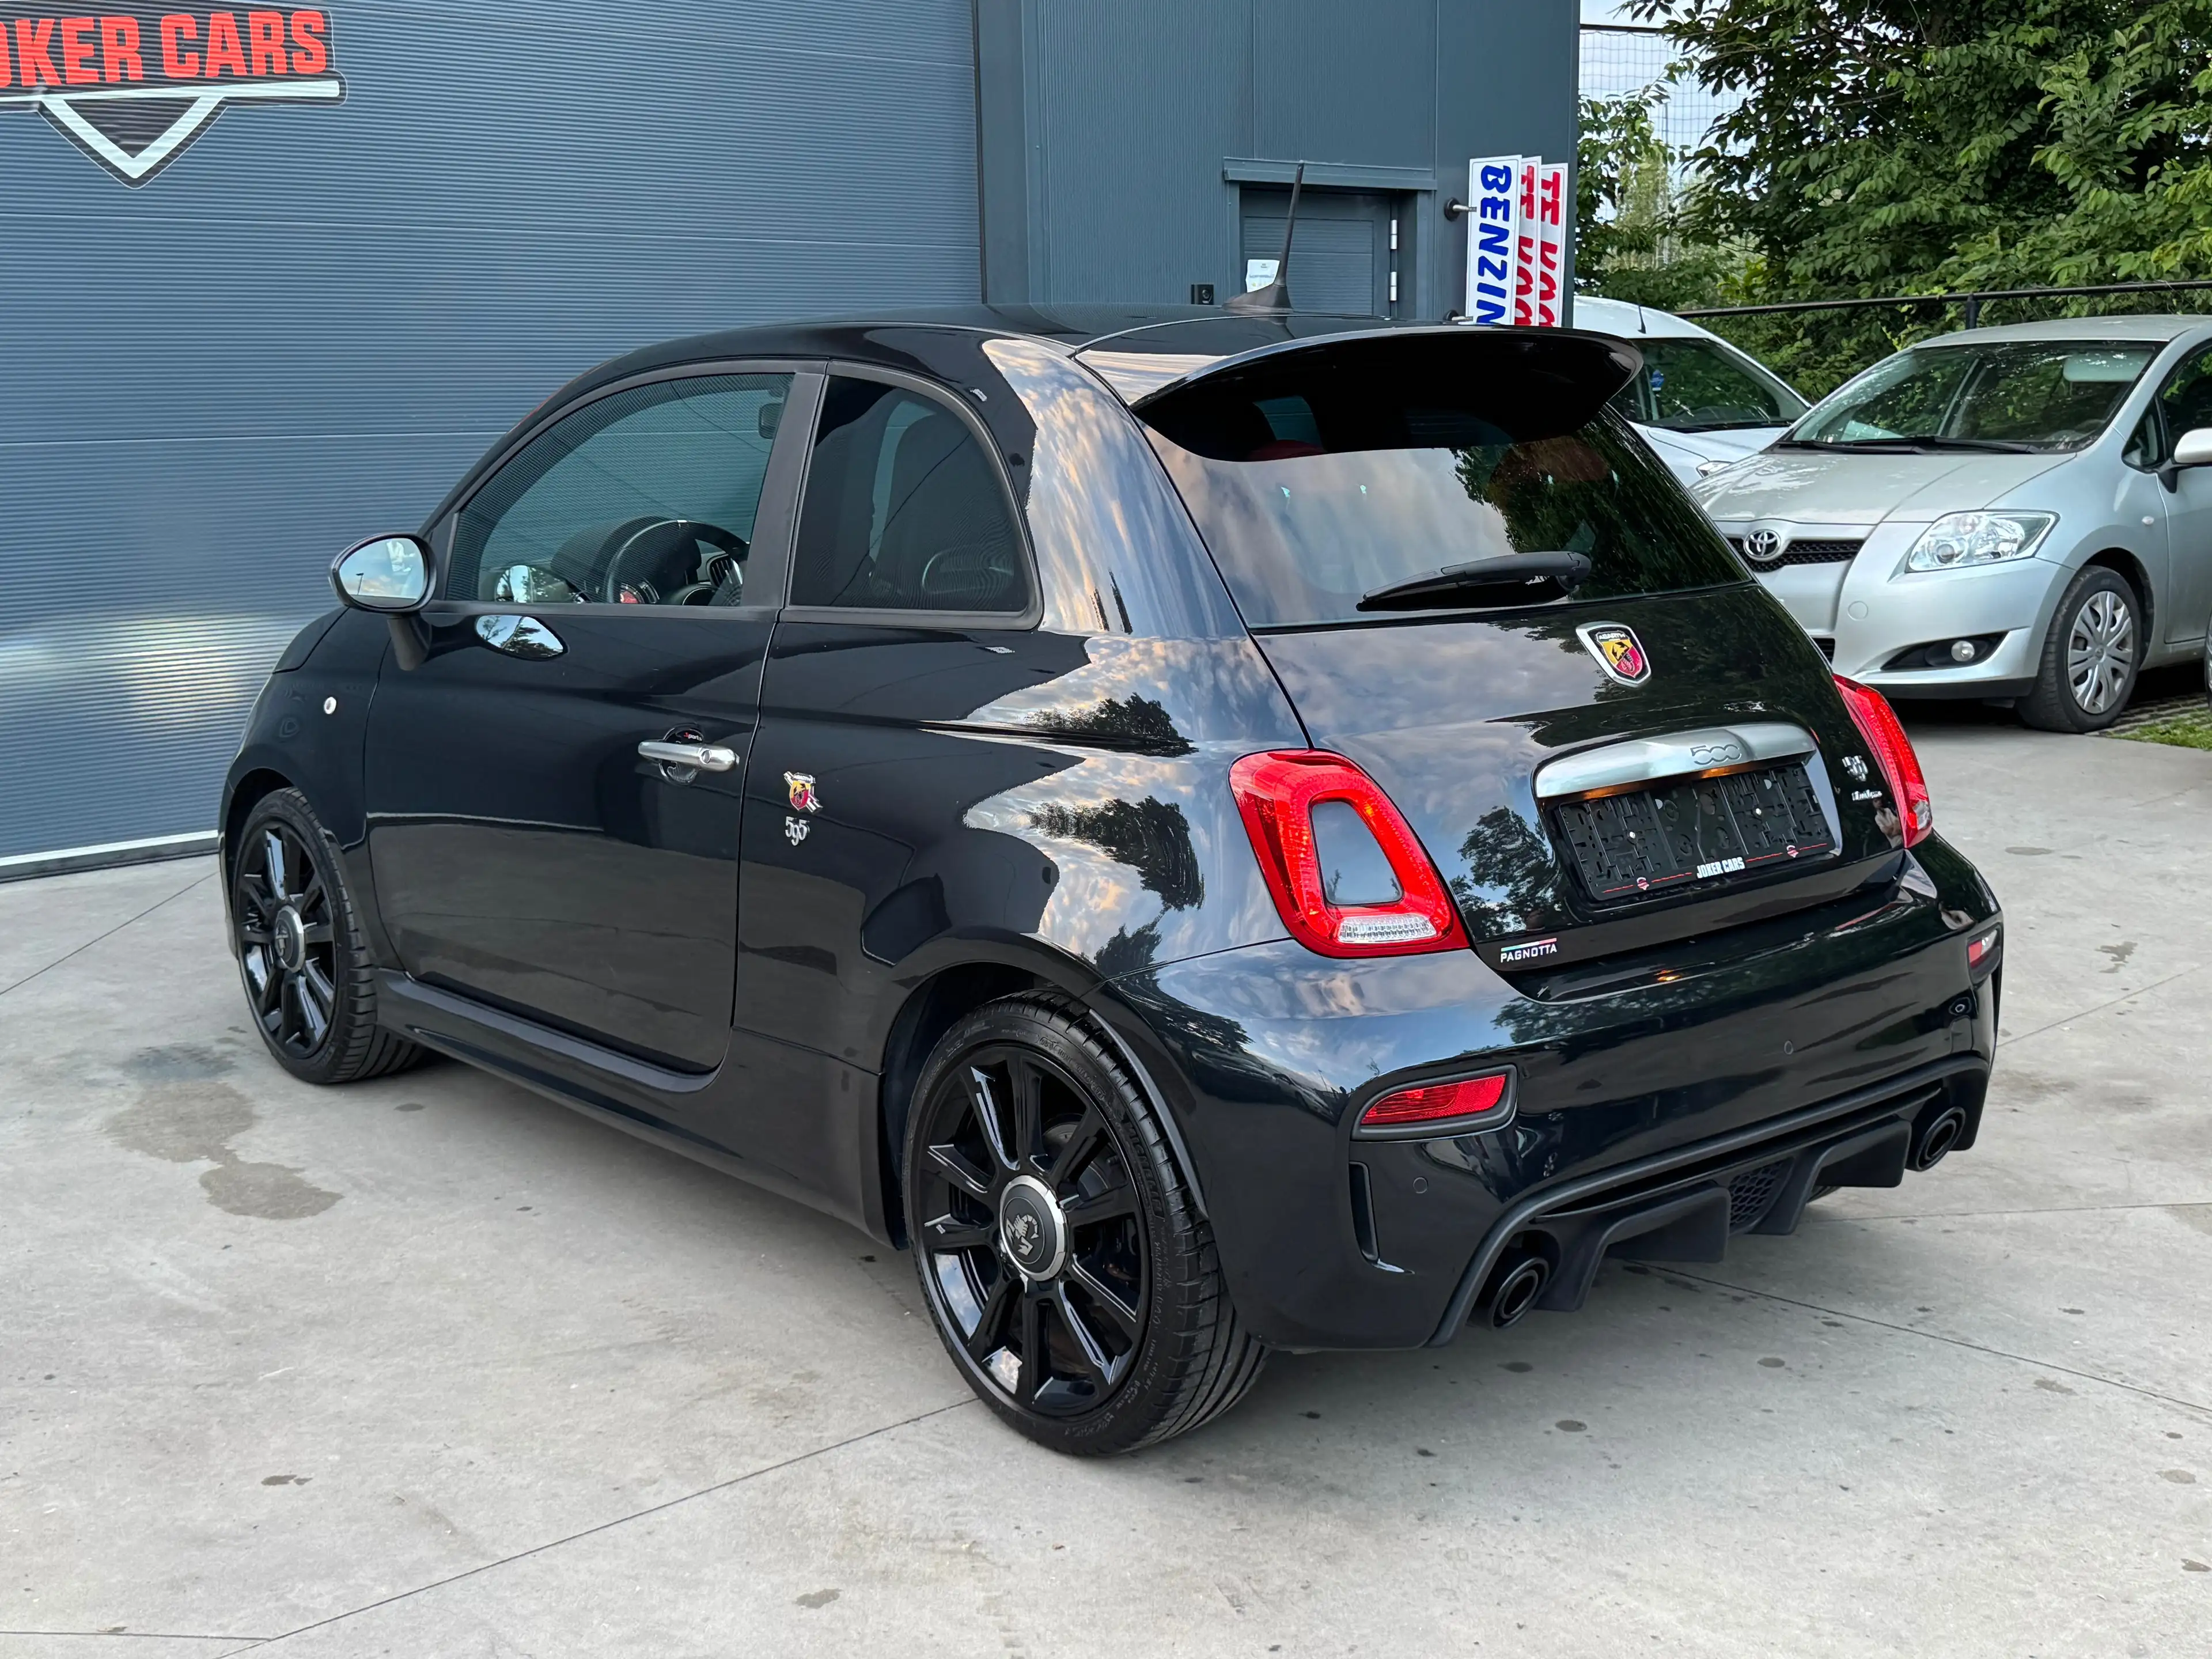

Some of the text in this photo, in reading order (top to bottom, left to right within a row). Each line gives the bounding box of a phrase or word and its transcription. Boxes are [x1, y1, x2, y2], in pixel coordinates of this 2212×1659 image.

[161, 10, 327, 78] CARS
[1690, 744, 1741, 765] 500
[785, 816, 810, 846] 595
[1696, 857, 1745, 878] JOKER CARS
[1500, 944, 1558, 963] PAGNOTTA
